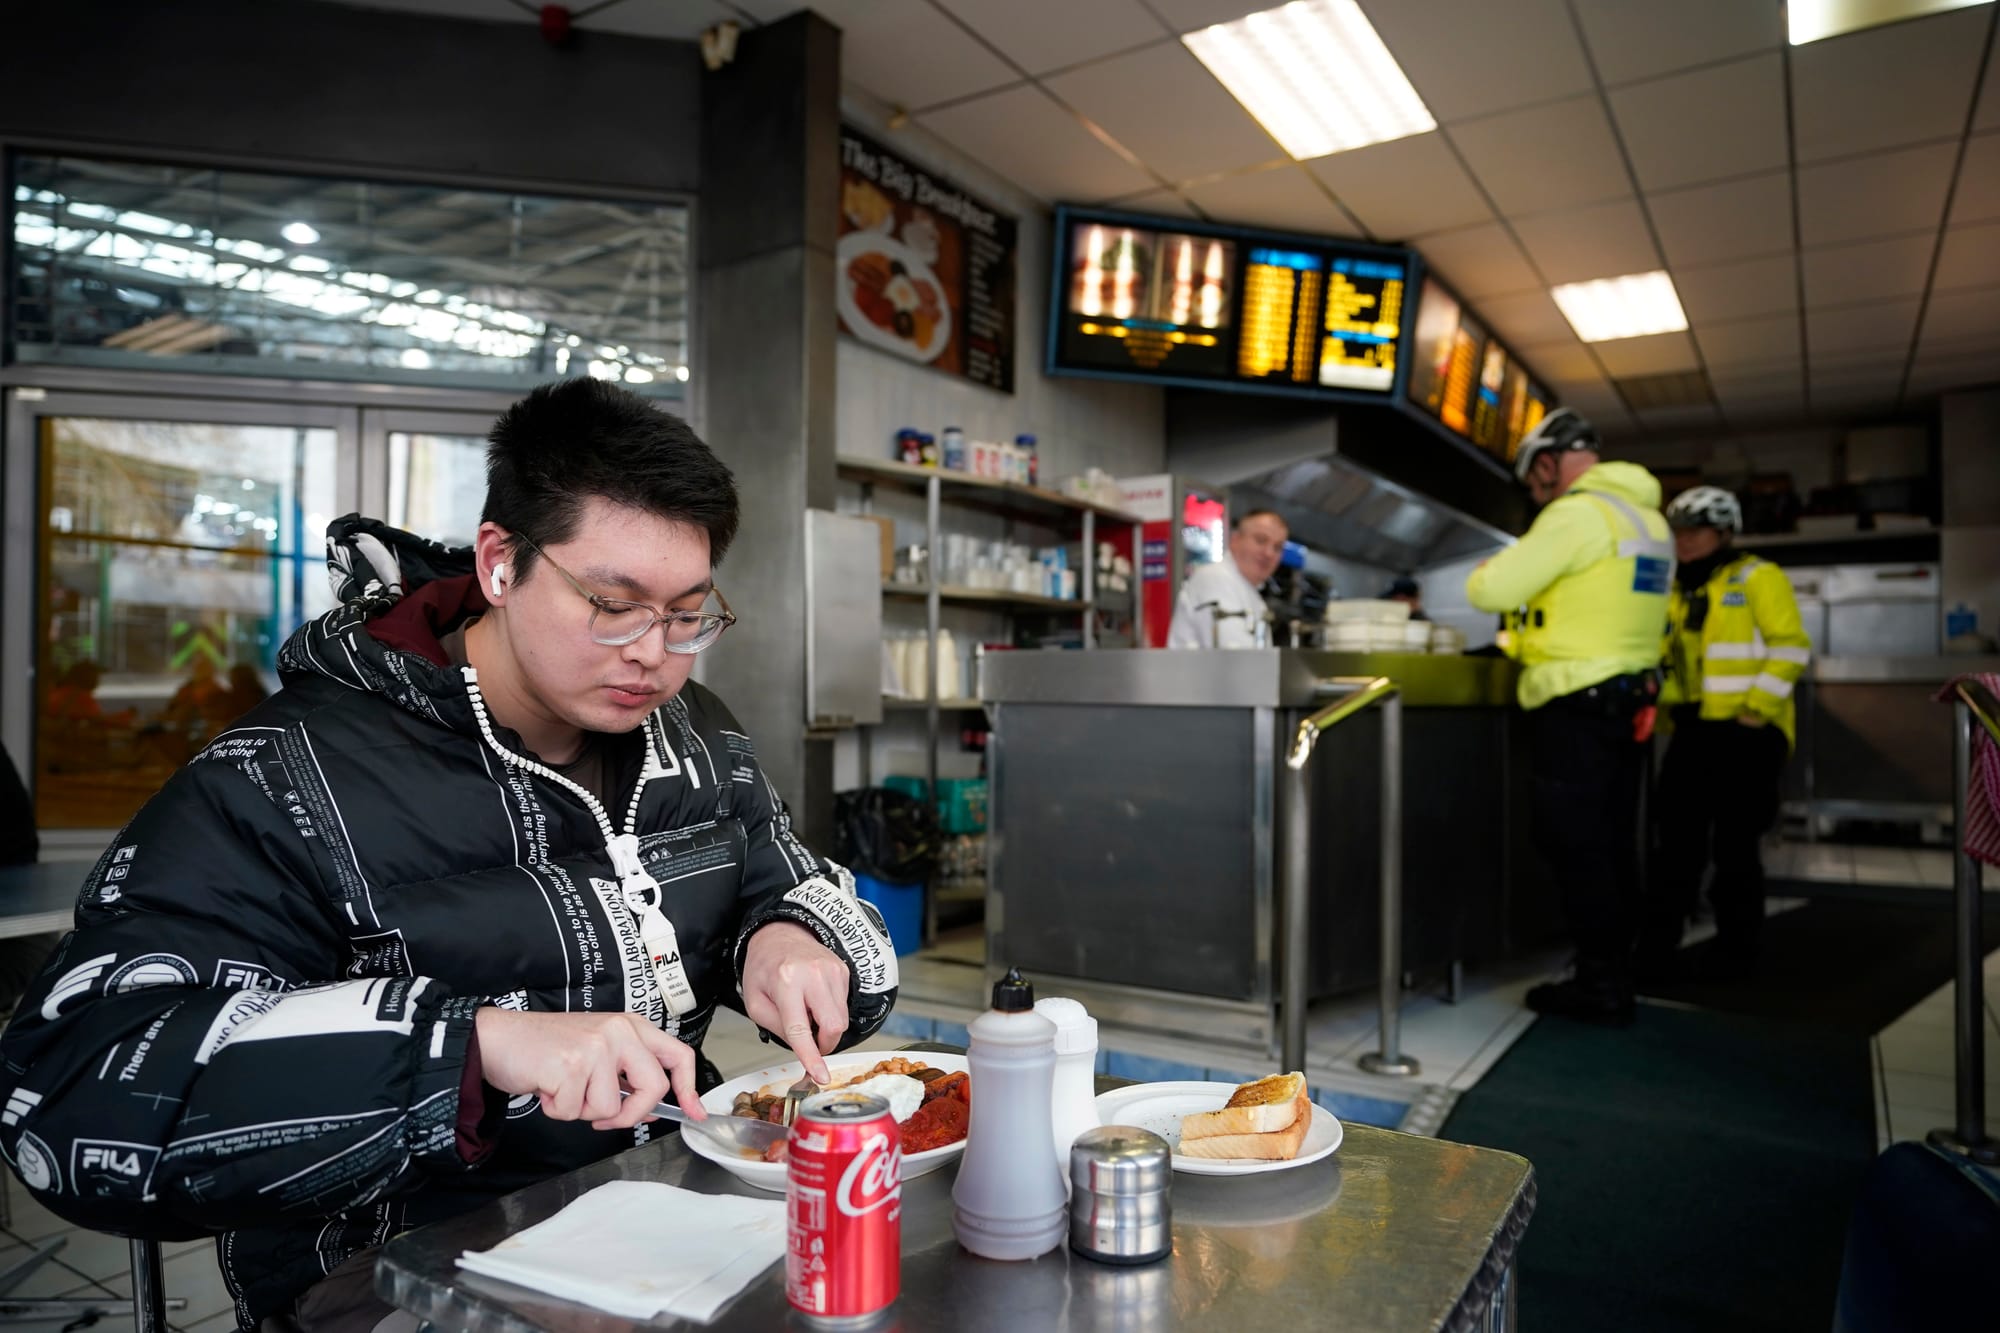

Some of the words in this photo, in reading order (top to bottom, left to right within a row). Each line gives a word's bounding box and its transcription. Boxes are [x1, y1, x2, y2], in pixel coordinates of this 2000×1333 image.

[842, 137, 879, 180] The
[879, 156, 914, 199] Big
[226, 739, 254, 747] ways
[254, 738, 267, 746] to
[508, 777, 531, 813] though
[523, 816, 533, 829] as
[525, 831, 534, 840] is
[528, 843, 538, 865] One
[549, 875, 570, 896] your
[597, 881, 612, 893] IS
[806, 884, 833, 899] FILA
[563, 898, 577, 916] live
[573, 894, 584, 907] as
[834, 896, 853, 914] ONE
[579, 909, 589, 918] is
[572, 919, 582, 930] to
[584, 920, 599, 949] other
[800, 892, 871, 974] COLLABORATION
[577, 932, 590, 961] ways
[602, 893, 647, 999] COLLABORATION
[594, 952, 604, 973] The
[654, 951, 680, 969] FILA
[583, 963, 593, 983] two
[874, 962, 886, 986] ONE
[581, 984, 595, 1009] only
[649, 995, 664, 1022] ONE
[119, 1042, 151, 1082] There
[144, 1020, 165, 1040] are
[225, 1135, 249, 1147] ways
[250, 1132, 260, 1140] to
[262, 1129, 279, 1139] live
[280, 1127, 302, 1138] your
[83, 1148, 141, 1176] FILA
